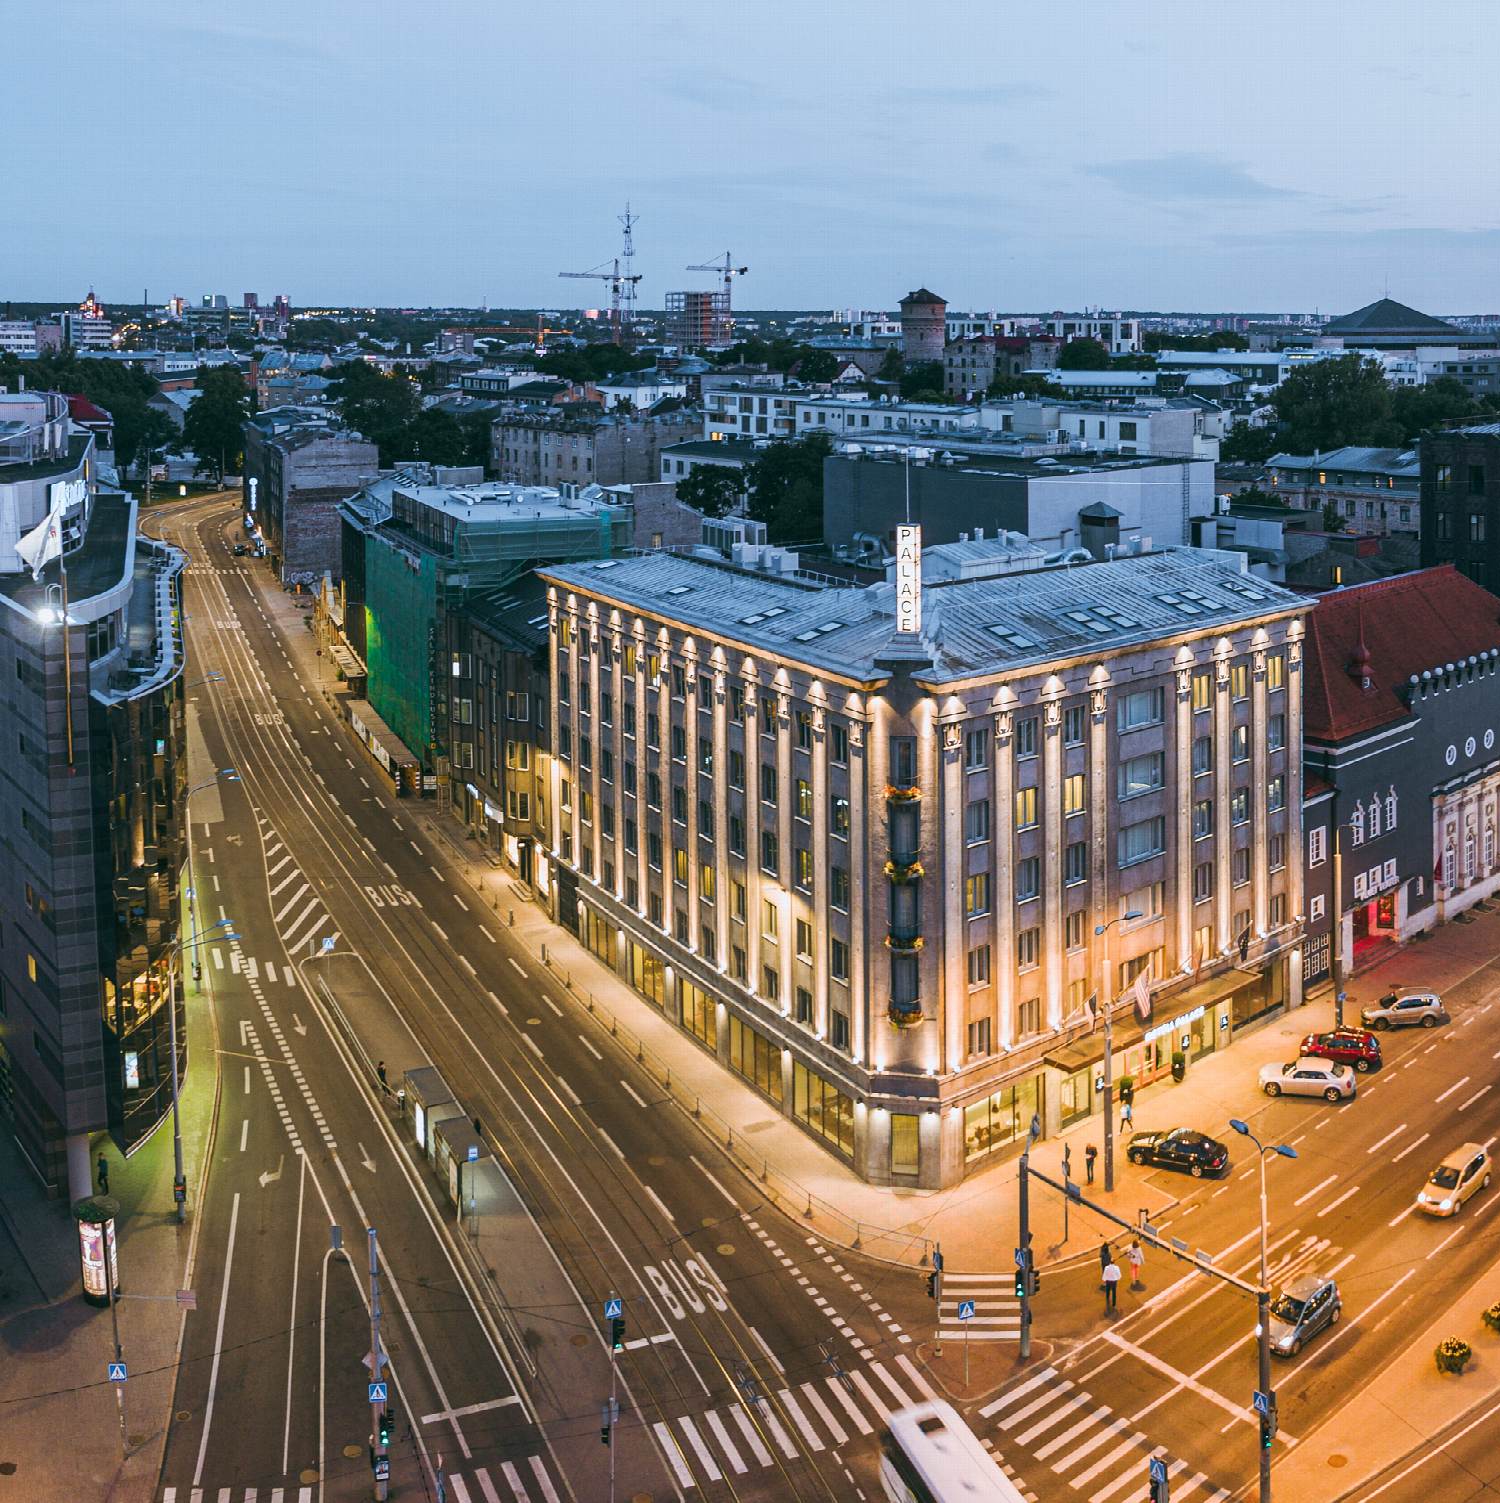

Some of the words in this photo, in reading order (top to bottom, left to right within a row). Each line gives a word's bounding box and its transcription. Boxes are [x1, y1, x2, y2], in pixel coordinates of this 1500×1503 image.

[901, 529, 911, 631] PALACE
[254, 713, 283, 725] BUS
[364, 884, 411, 906] BUS
[643, 1259, 728, 1321] BUS
